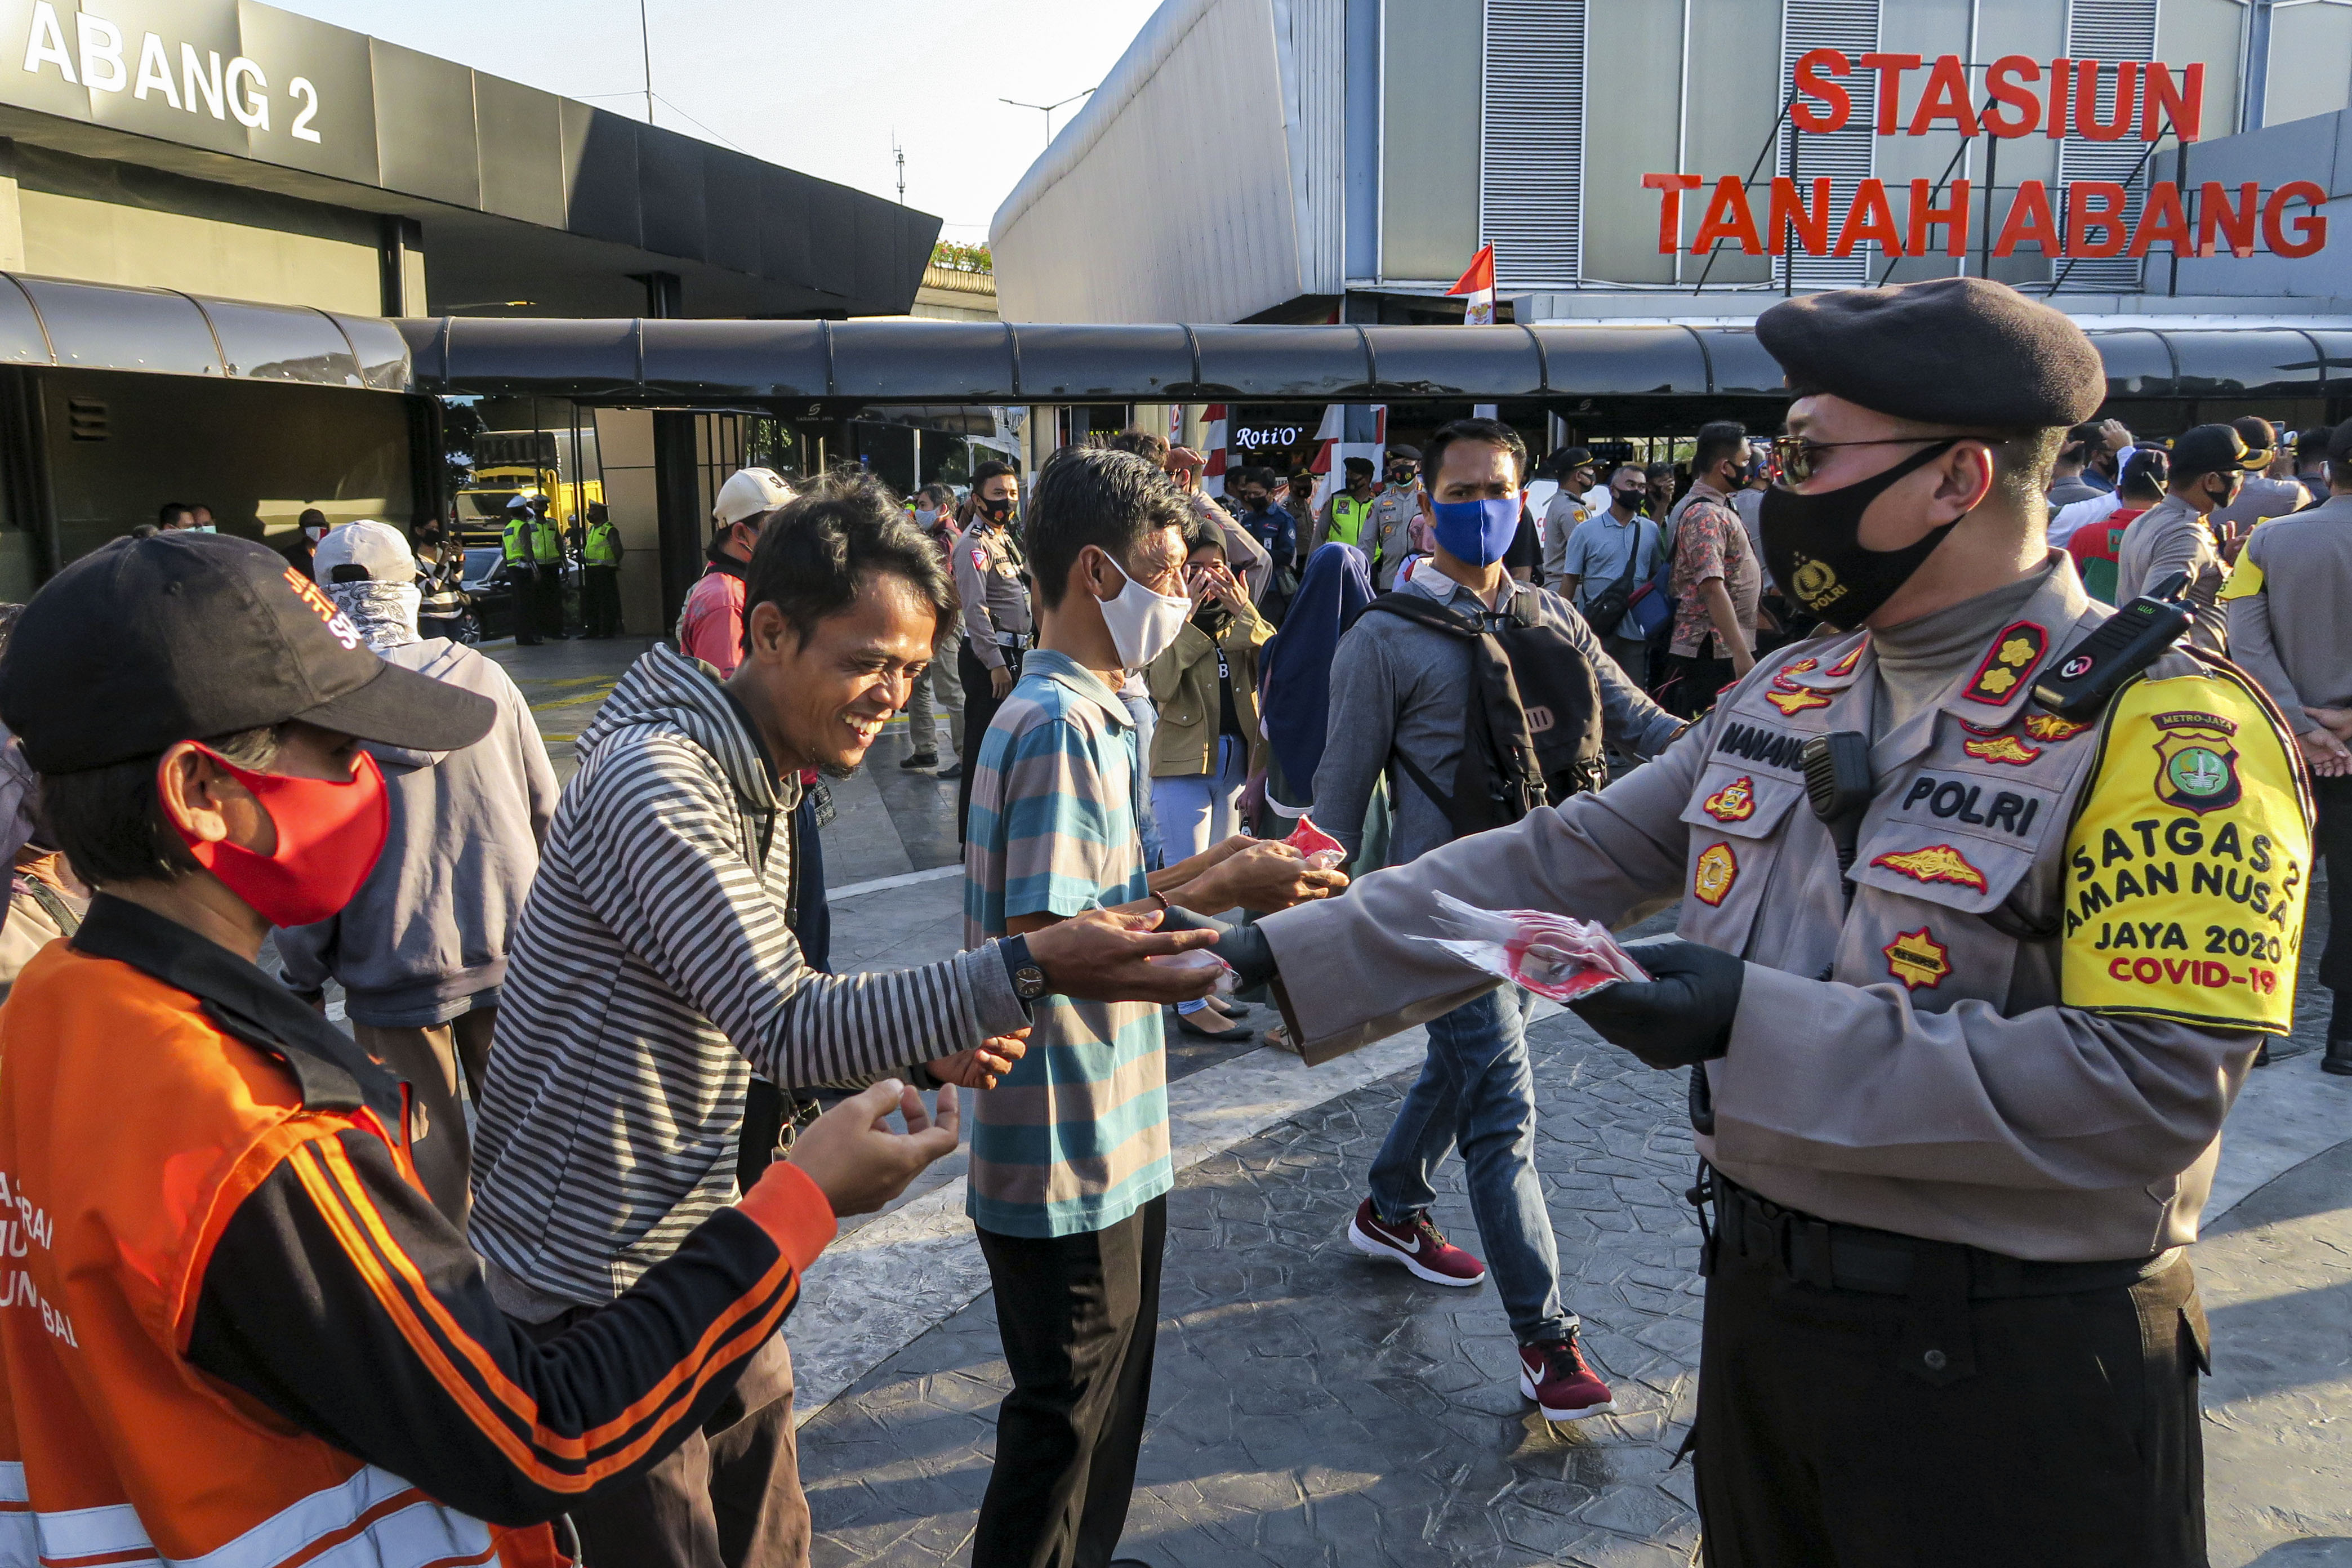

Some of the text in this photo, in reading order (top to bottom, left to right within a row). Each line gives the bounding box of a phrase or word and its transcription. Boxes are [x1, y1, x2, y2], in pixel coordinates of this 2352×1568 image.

[23, 0, 322, 144] ABANG 2
[1788, 48, 2206, 142] STASIUN
[1640, 173, 2328, 259] TANAH ABANG
[1810, 584, 1848, 611] POLRI
[2162, 714, 2233, 730] METRO-JAYA
[1903, 777, 2039, 836] POLRI
[2072, 817, 2272, 882] SATGAS
[2066, 861, 2179, 938] AMAN
[2191, 862, 2287, 933] NUSA
[2095, 922, 2282, 964] JAYA 2020
[2108, 957, 2277, 995] COVID-19
